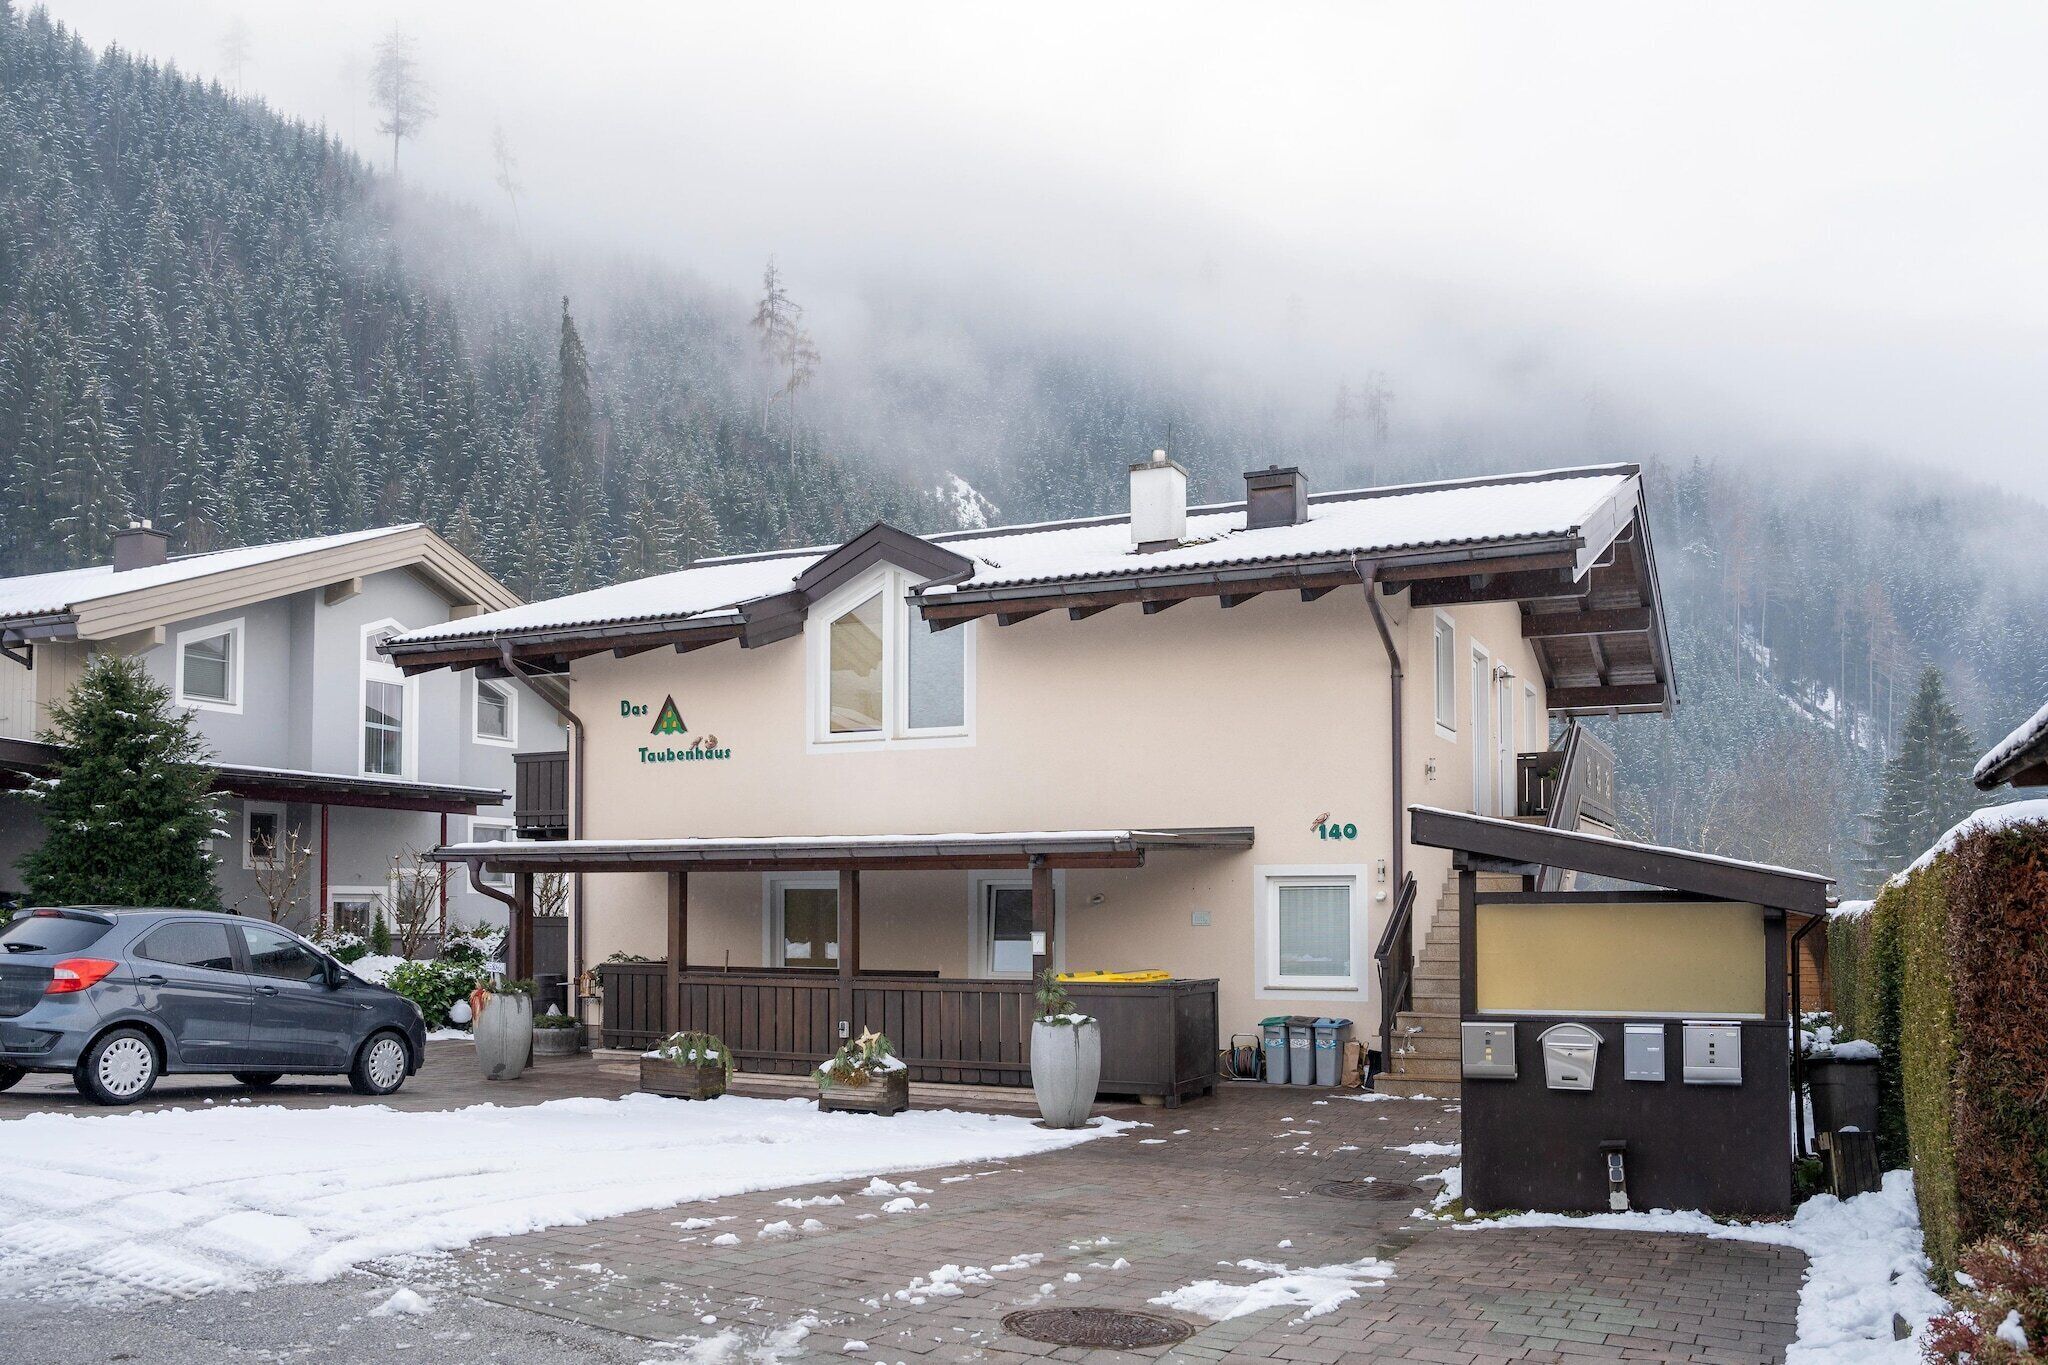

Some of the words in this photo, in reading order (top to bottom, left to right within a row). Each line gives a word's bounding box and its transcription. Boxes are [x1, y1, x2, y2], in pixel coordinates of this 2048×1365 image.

[620, 700, 649, 717] Das
[638, 746, 731, 763] Taubenhaus
[1318, 823, 1358, 840] 140
